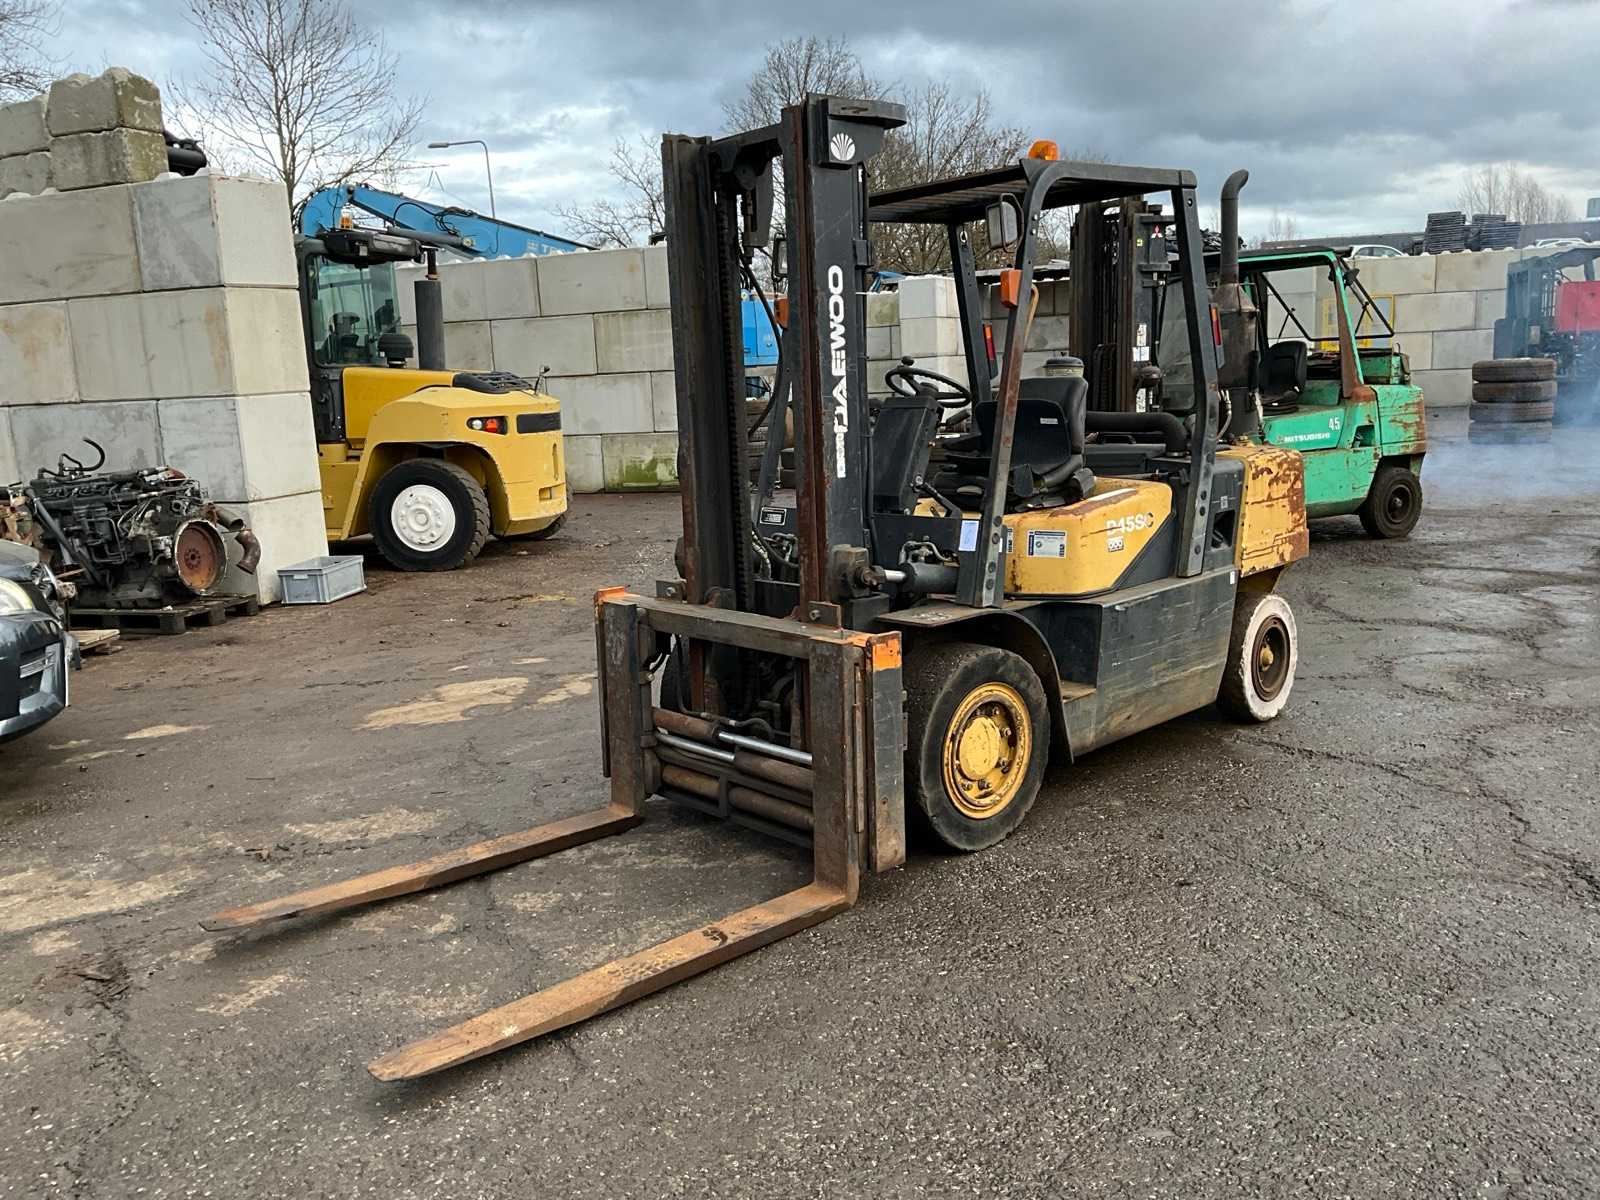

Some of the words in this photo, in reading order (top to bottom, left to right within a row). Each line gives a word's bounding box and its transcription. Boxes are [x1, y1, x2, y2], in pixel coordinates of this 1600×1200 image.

[827, 264, 849, 433] DAEWOO
[1328, 416, 1341, 431] 45
[1283, 432, 1331, 443] MITSUBISHI
